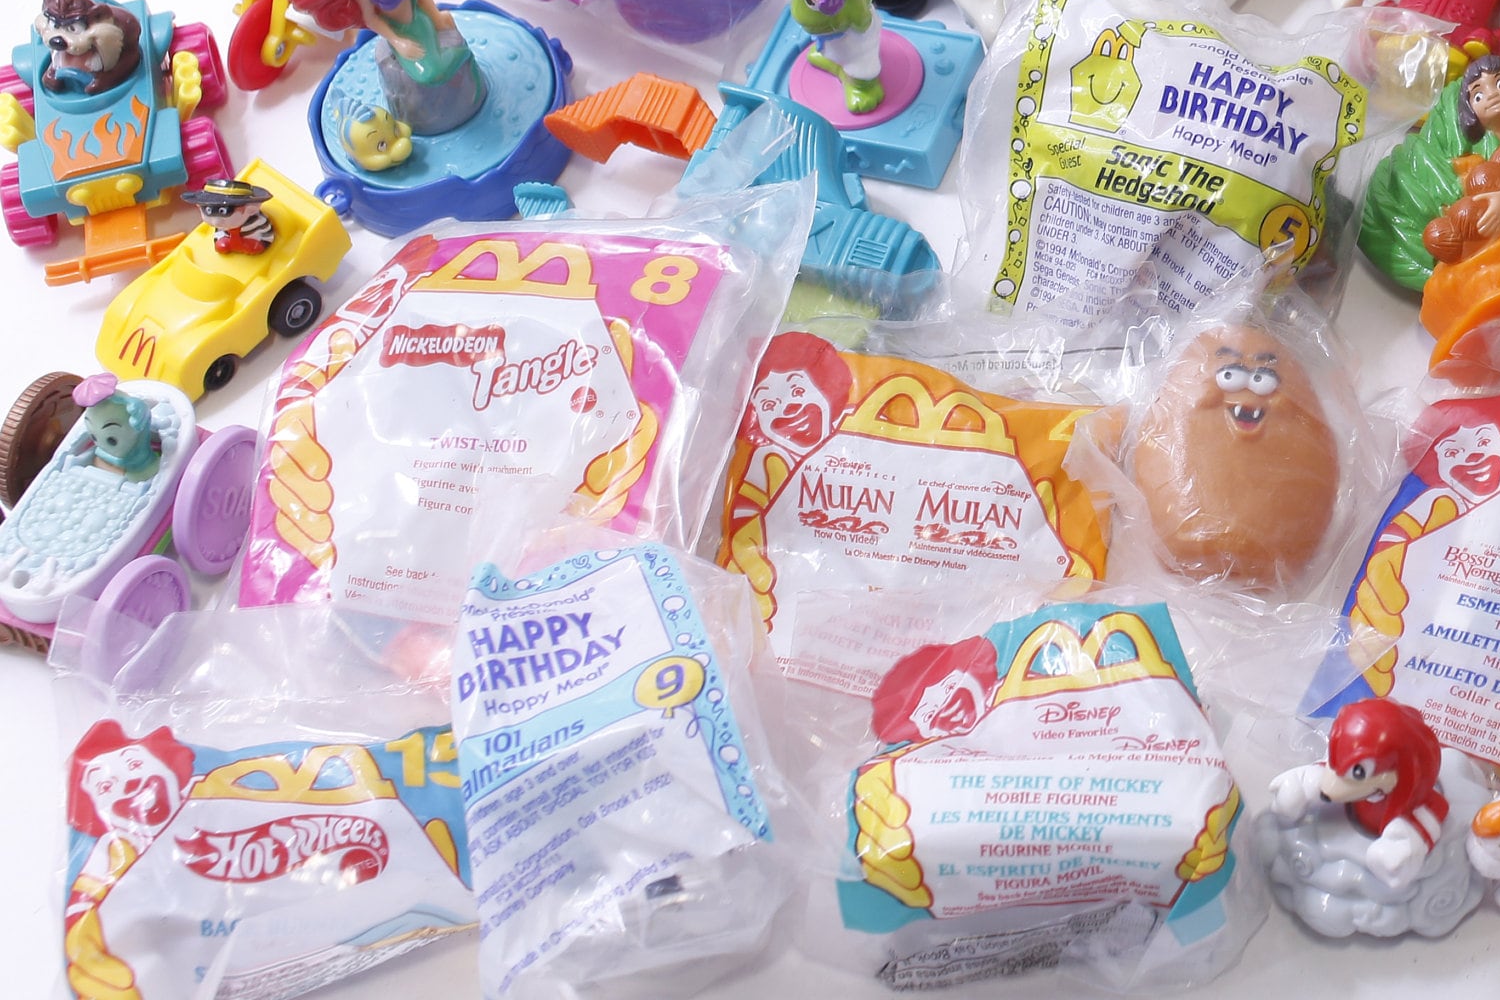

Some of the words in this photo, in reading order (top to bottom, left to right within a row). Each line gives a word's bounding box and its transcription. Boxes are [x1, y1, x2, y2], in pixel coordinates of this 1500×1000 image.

[1189, 61, 1294, 119] HAPPY
[1159, 85, 1309, 156] BIRTHDAY
[1172, 125, 1226, 152] Happy
[1106, 145, 1173, 179] Sonic
[1178, 160, 1225, 193] The
[1102, 205, 1135, 221] children
[1036, 224, 1065, 242] UNDER
[1040, 213, 1075, 231] children
[1117, 237, 1148, 253] ABOUT
[629, 254, 700, 306] 8
[388, 335, 499, 355] NICKELODEON
[471, 339, 598, 411] Tangle
[413, 459, 457, 471] Figurine
[204, 485, 251, 519] SOA
[417, 497, 451, 512] Figura
[798, 471, 895, 516] MULAN
[915, 486, 1022, 531] MULAN
[1437, 573, 1477, 590] Maintenant
[468, 611, 594, 659] HAPPY
[457, 625, 627, 703] BIRTHDAY
[1404, 656, 1488, 688] AMULETO
[654, 663, 684, 701] 9
[484, 690, 548, 717] Happy
[1425, 698, 1443, 711] See
[1445, 702, 1467, 718] back
[1449, 685, 1491, 707] Collar
[1034, 701, 1122, 726] Disney
[1031, 728, 1066, 741] Video
[1068, 725, 1120, 739] Favorites
[1443, 717, 1487, 739] touchant
[483, 729, 522, 758] 101
[385, 731, 461, 788] 15
[949, 775, 986, 790] THE
[990, 776, 1052, 790] SPIRIT
[1058, 777, 1084, 790] OF
[1089, 777, 1165, 794] MICKEY
[984, 792, 1041, 805] MOBILE
[1046, 793, 1118, 806] FIGURINE
[930, 811, 960, 825] LES
[967, 810, 1071, 825] MEILLEURS
[1075, 812, 1173, 827] MOMENTS
[1000, 825, 1025, 841] DE
[1031, 826, 1104, 842] MICKEY
[980, 844, 1052, 858] FIGURINE
[1057, 844, 1113, 854] MOBILE
[938, 863, 960, 876] EL
[1058, 857, 1084, 873] DE
[994, 876, 1051, 890] FIGURA
[1056, 866, 1104, 884] MOVIL
